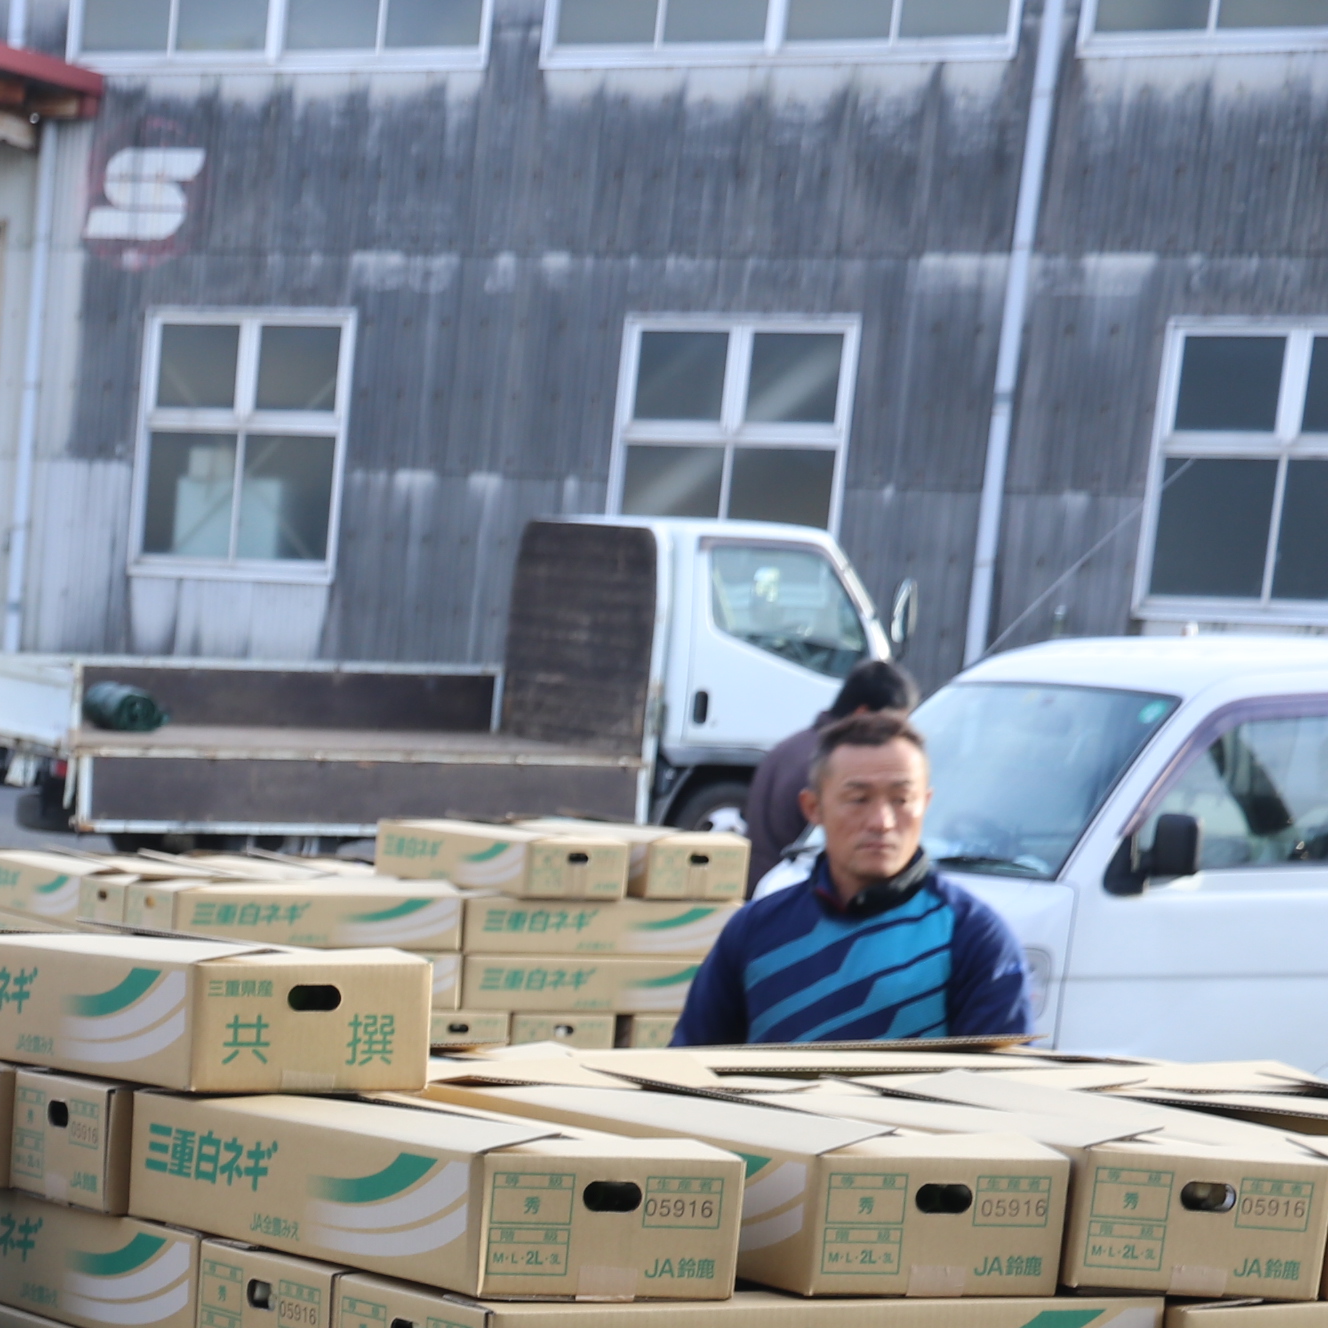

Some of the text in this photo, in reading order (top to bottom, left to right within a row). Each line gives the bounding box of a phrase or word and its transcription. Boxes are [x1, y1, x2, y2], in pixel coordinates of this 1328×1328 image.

[210, 980, 273, 997] 三重県産
[223, 1015, 395, 1065] 共 撰
[146, 1124, 277, 1189] 三重白ネギ
[525, 1197, 540, 1213] 秀
[644, 1196, 713, 1218] 05916
[981, 1197, 1047, 1220] 05916
[1242, 1198, 1305, 1217] 05916
[645, 1259, 715, 1279] JA鈴鹿
[974, 1256, 1042, 1276] JA鈴鹿
[1234, 1259, 1300, 1280] JA鈴鹿
[279, 1300, 316, 1325] 05916
